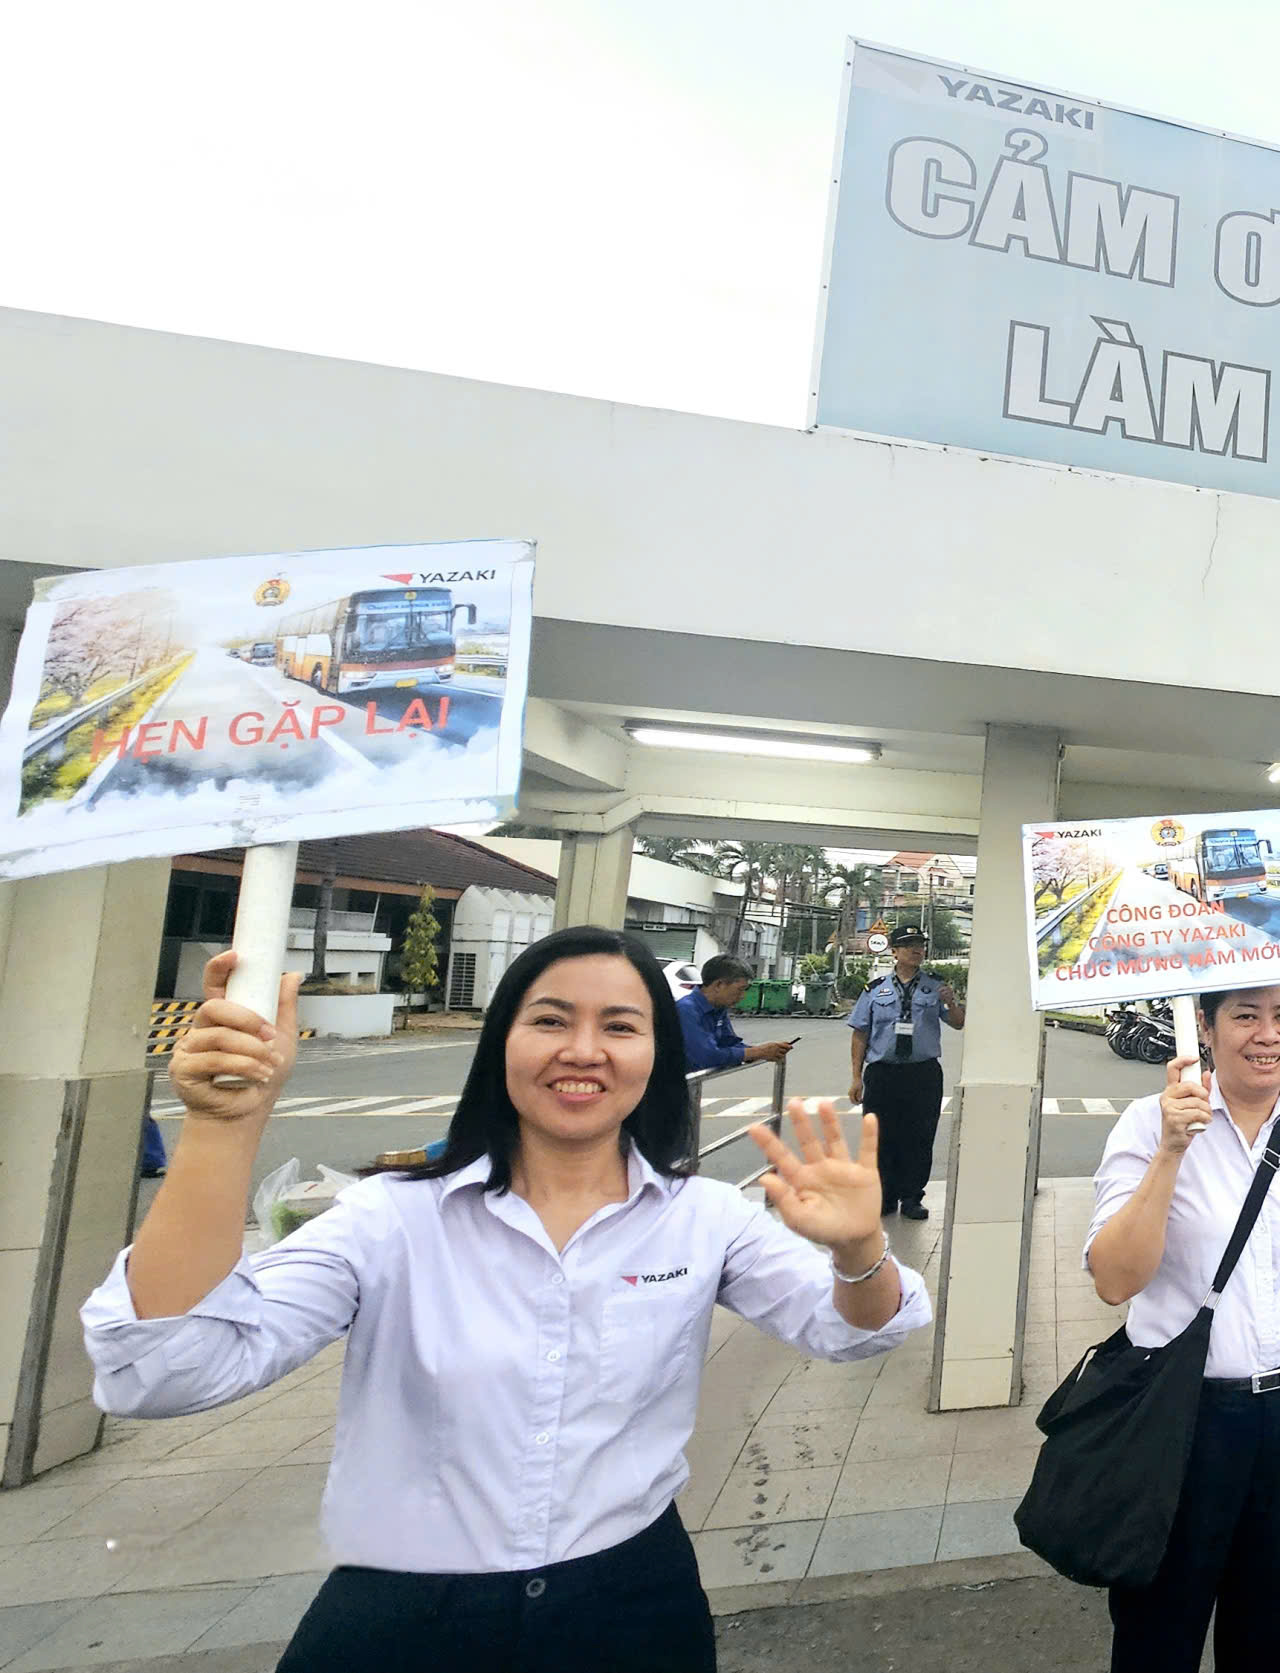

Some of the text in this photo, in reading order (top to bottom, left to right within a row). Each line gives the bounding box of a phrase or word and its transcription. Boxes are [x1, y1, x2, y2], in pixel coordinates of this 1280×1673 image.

[937, 74, 1094, 131] YAZAKI
[885, 127, 1181, 289] CẢM
[1002, 314, 1272, 464] LÀM
[419, 569, 497, 585] YAZAKI
[89, 696, 451, 765] HẸN GẶP LẠI
[1057, 829, 1102, 839] YAZAKI
[1106, 904, 1162, 924] CÔNG
[1088, 923, 1247, 952] CÔNG TY YAZAKI
[1241, 942, 1280, 962] MỚI
[641, 1267, 688, 1284] YAZAKI
